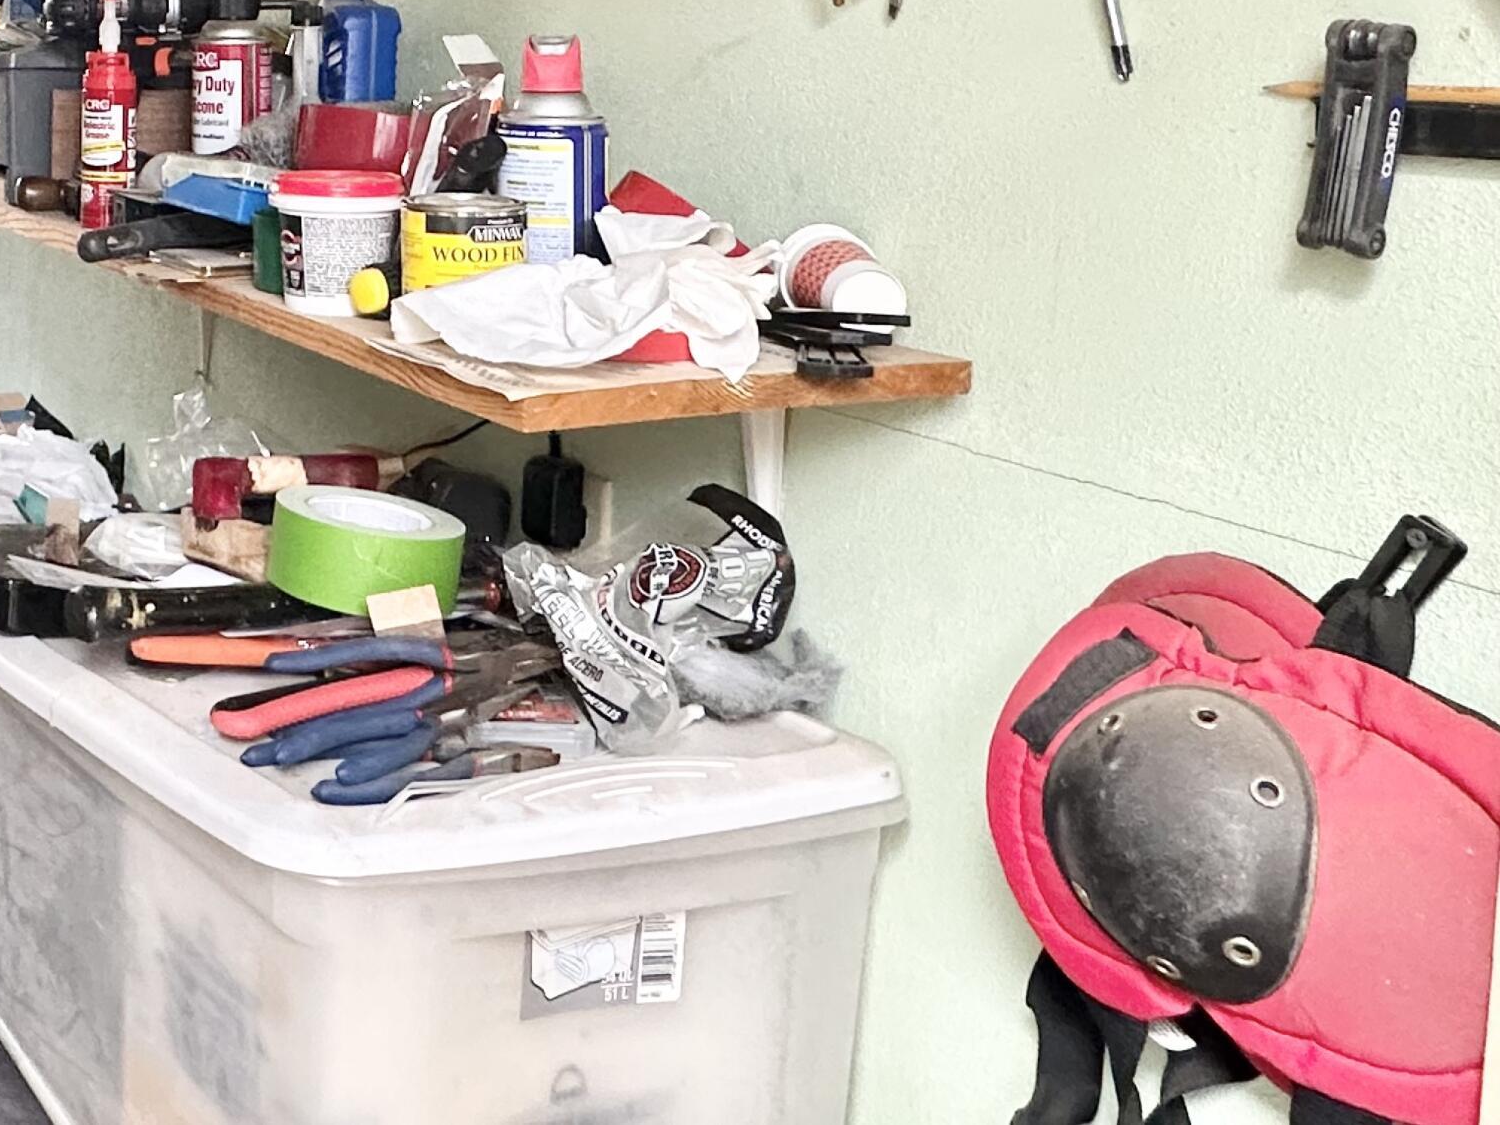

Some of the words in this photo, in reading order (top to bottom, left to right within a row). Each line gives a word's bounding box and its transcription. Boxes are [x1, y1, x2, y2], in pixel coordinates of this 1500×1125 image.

[194, 51, 219, 69] RC
[205, 75, 235, 96] Duty
[432, 246, 498, 263] WOOD
[568, 656, 605, 683] ACERO
